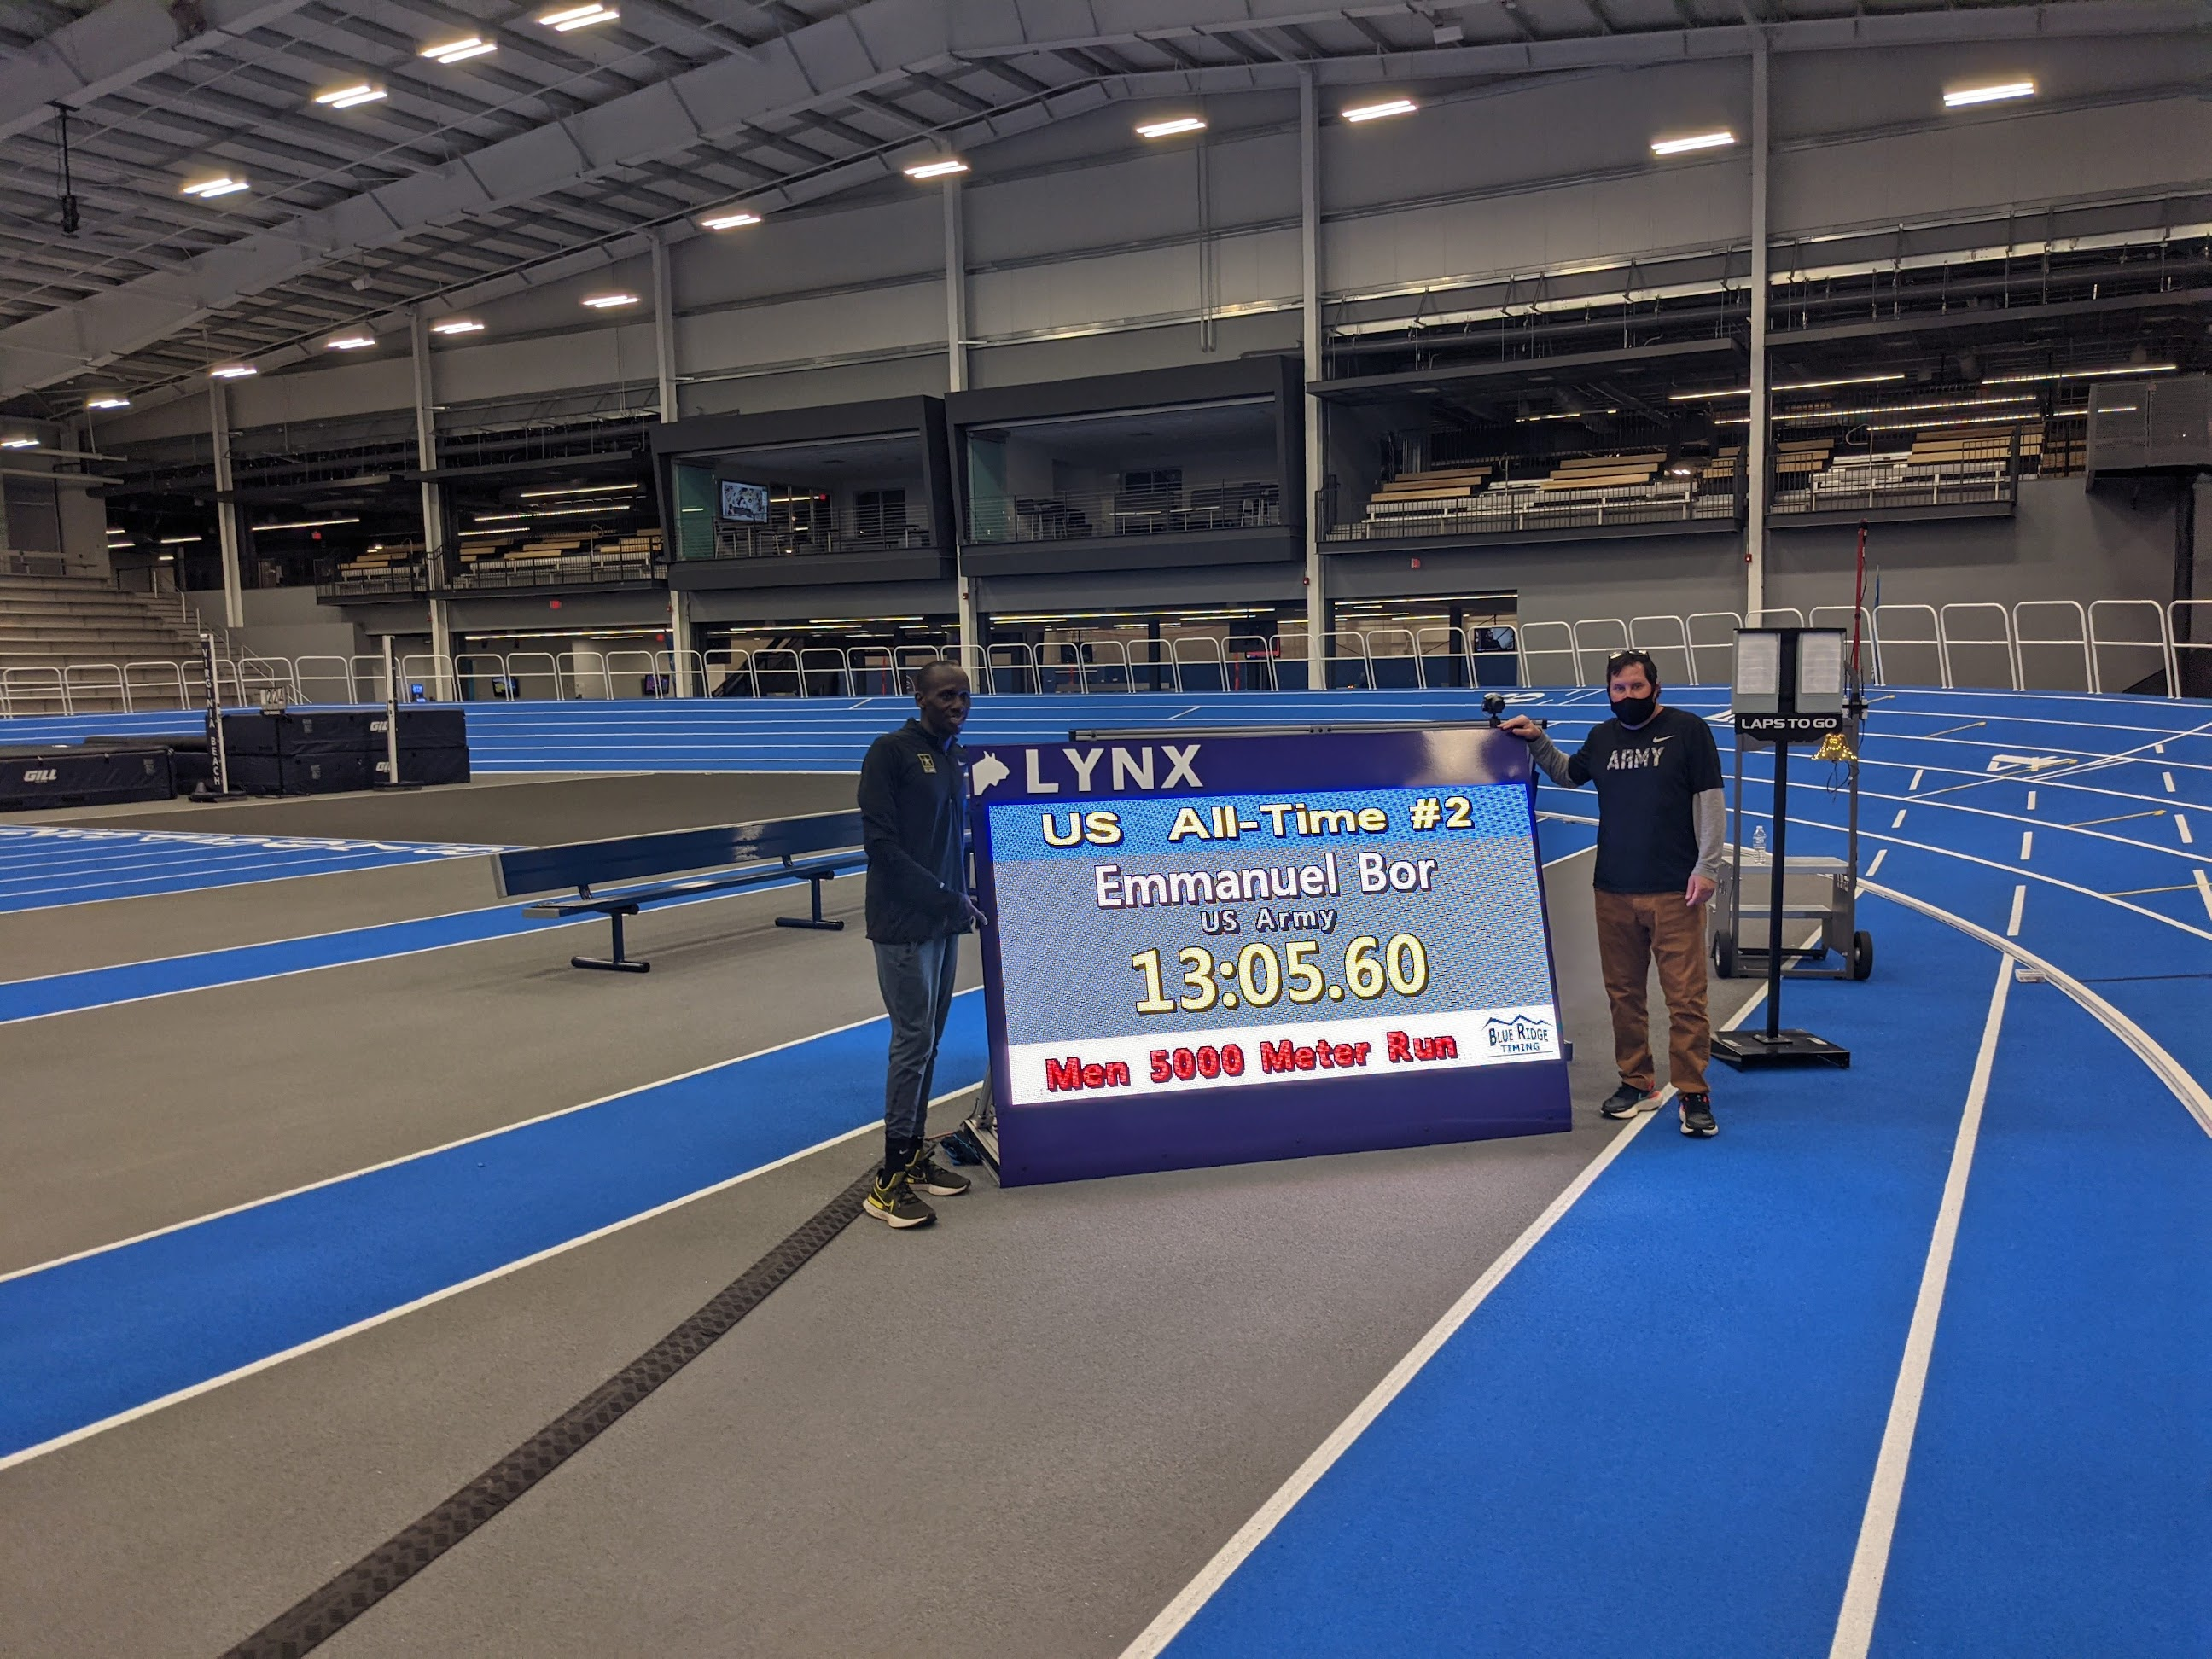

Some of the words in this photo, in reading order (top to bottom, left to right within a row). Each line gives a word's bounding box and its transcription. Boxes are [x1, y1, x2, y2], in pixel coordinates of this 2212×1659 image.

[201, 649, 216, 728] VIRGINIA
[210, 736, 221, 785] BEACH
[370, 721, 390, 731] GIL
[1742, 719, 1786, 730] LAPS
[1788, 719, 1811, 729] TO
[1813, 718, 1837, 729] GO
[1026, 744, 1204, 795] LYNX
[1607, 747, 1665, 770] ARMY
[24, 769, 57, 782] GILL
[1041, 812, 1121, 847] US
[1168, 803, 1389, 842] All-Time
[1410, 796, 1474, 830] #2
[1095, 854, 1339, 910] Emmanuel
[1359, 851, 1439, 895] Bor
[1201, 911, 1240, 935] US
[1256, 906, 1337, 933] Army
[1132, 934, 1429, 1015] 13:05.60
[1489, 1028, 1514, 1046] BLUE
[1517, 1023, 1548, 1041] RIDGE
[1501, 1043, 1540, 1052] TIMING
[1045, 1057, 1129, 1093] Men
[1150, 1044, 1245, 1084] 5000
[1260, 1038, 1371, 1075] Meter
[1388, 1031, 1458, 1062] Run
